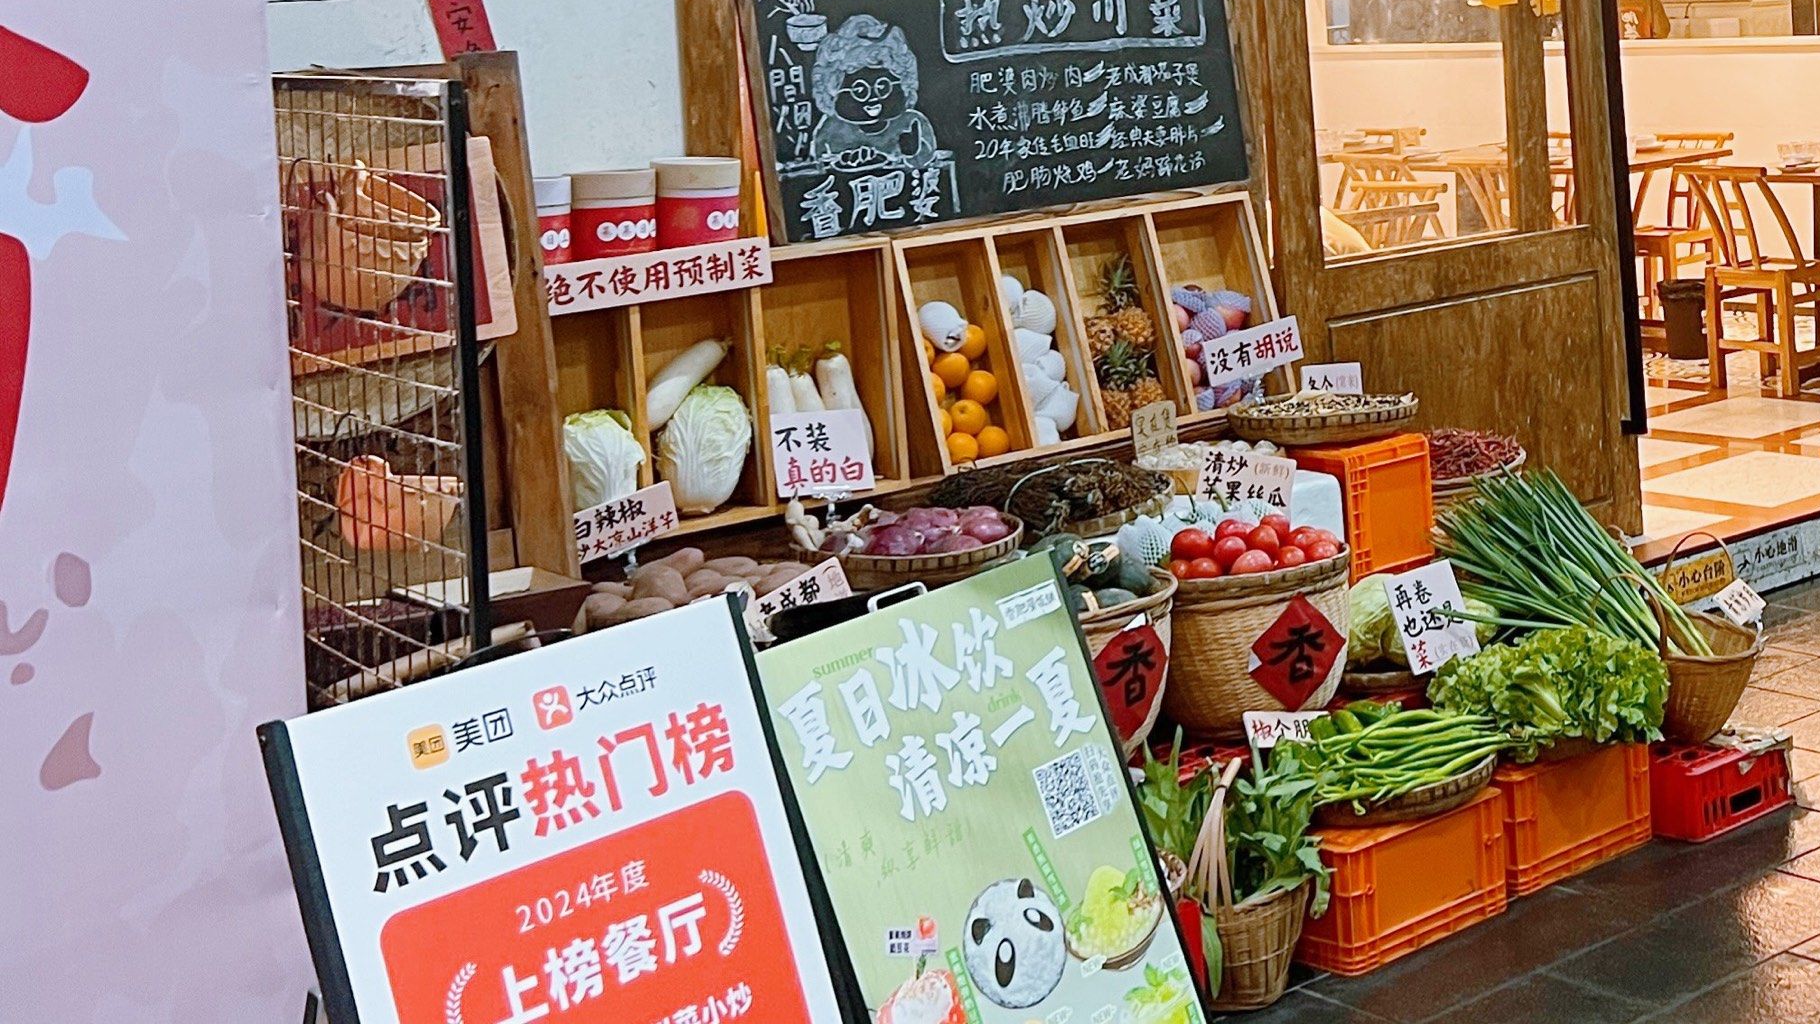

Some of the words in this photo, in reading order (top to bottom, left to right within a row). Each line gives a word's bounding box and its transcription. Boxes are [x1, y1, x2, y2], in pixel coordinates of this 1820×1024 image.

[800, 167, 942, 240] 香肥婆
[544, 244, 765, 306] 绝不使用预制菜
[1209, 325, 1299, 375] 没有胡说
[774, 423, 831, 453] 不装
[783, 456, 865, 490] 真的白
[1204, 450, 1249, 476] 清炒
[1202, 476, 1287, 508] 苹果丝瓜
[1394, 579, 1433, 611] 再卷
[1403, 599, 1465, 638] 也还是
[811, 646, 874, 679] summer
[1102, 642, 1158, 708] 香
[1267, 622, 1326, 684] 香
[1411, 639, 1433, 669] 菜
[576, 666, 659, 711] 大众点评
[778, 607, 1015, 785] 夏日冰饮
[987, 687, 1023, 713] drink
[413, 734, 446, 759] 美团
[452, 707, 514, 754] 美团
[884, 645, 1098, 822] 清凉一夏
[370, 701, 735, 895] 点评热门榜
[515, 858, 652, 935] 2024年度
[495, 890, 709, 1024] 上榜餐厅
[651, 982, 753, 1024] 菜小炒
